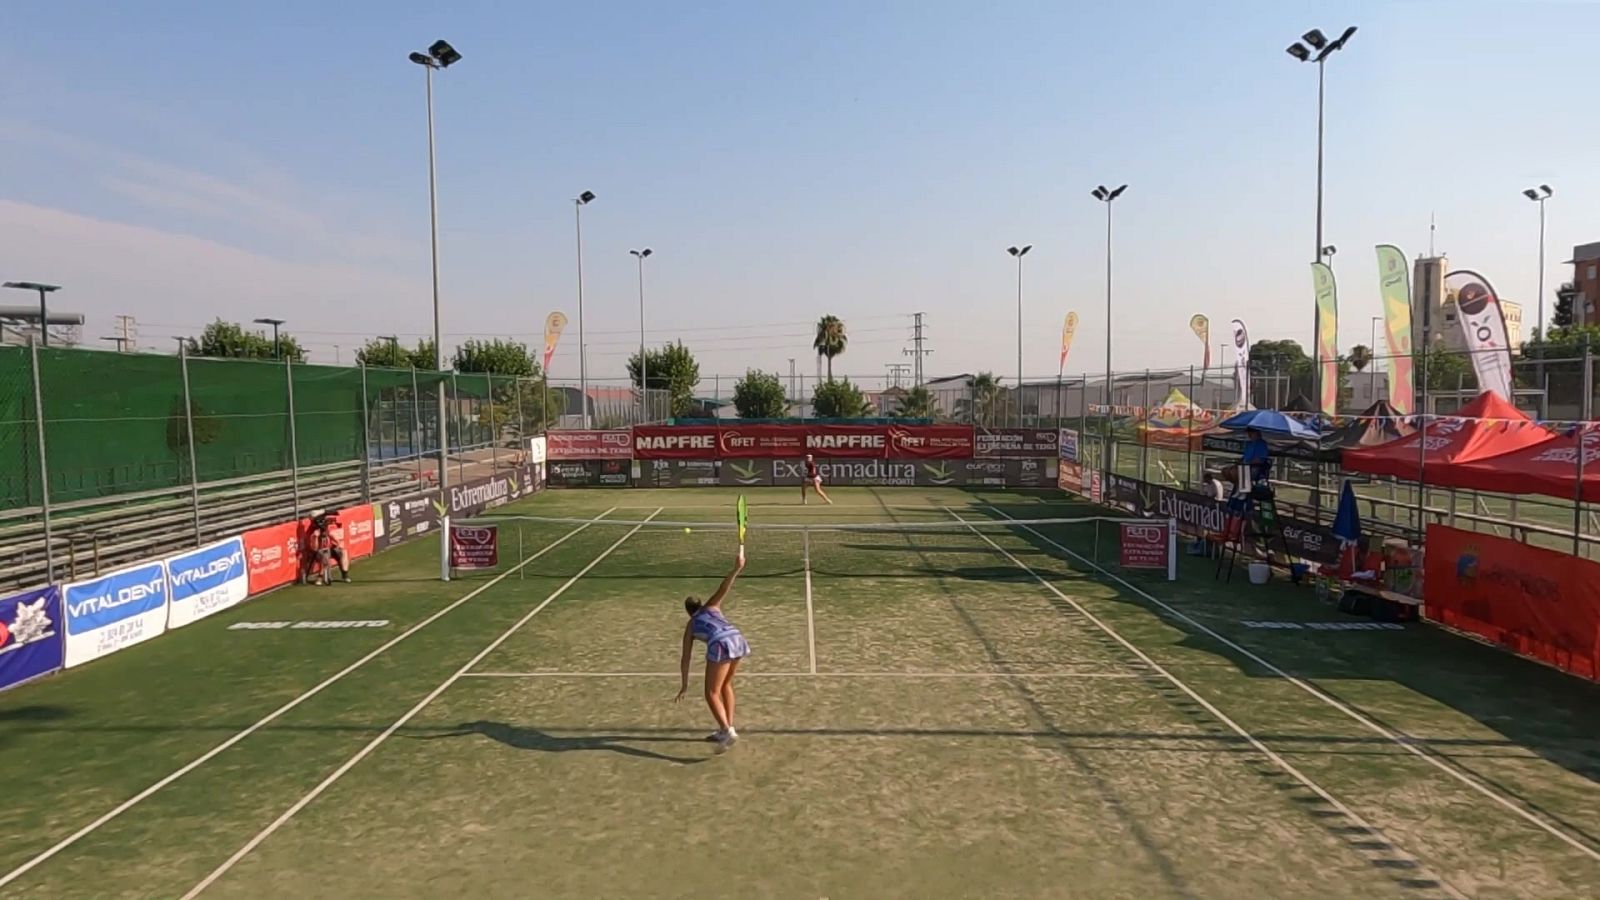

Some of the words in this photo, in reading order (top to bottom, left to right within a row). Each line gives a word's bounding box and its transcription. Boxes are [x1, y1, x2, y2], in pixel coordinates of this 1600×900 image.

[636, 435, 716, 450] MAPFRE
[730, 437, 756, 447] RFET
[806, 435, 885, 448] MAPFRE
[900, 437, 925, 447] RFET
[451, 476, 508, 513] Extremadura
[171, 551, 242, 587] VITALDENT
[68, 577, 163, 618] VITALDENT
